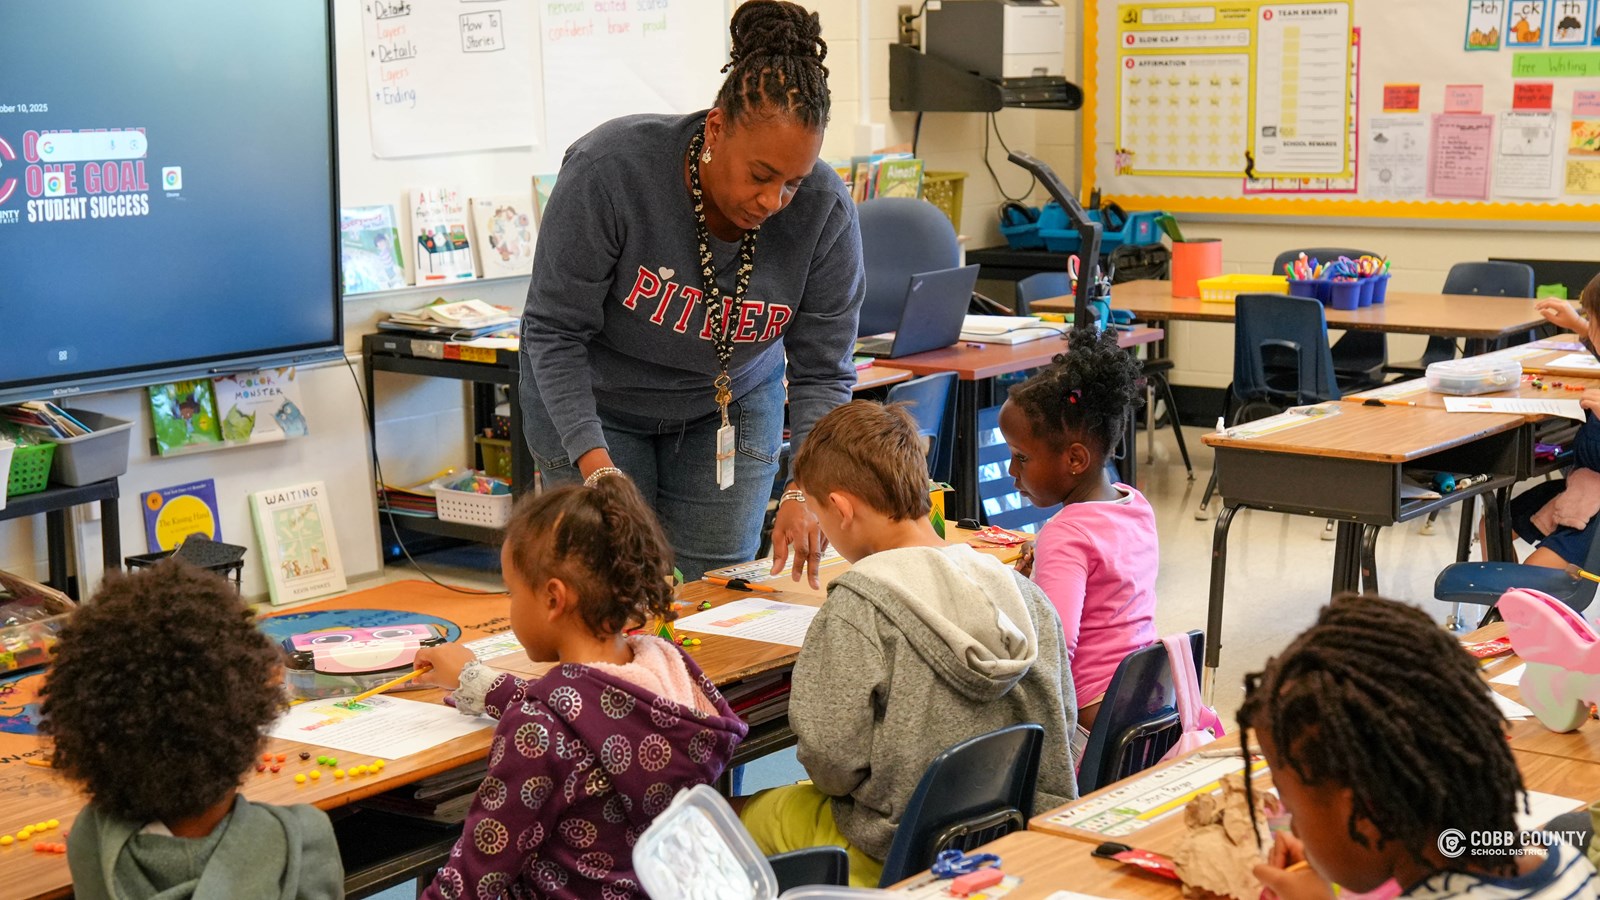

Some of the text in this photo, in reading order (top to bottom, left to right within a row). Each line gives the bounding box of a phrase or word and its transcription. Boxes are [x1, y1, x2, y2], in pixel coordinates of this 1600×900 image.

[1301, 8, 1338, 16] REWARDS
[377, 23, 406, 41] Layers
[463, 16, 482, 32] How
[467, 36, 495, 49] Stories
[379, 41, 418, 63] Details
[1139, 59, 1187, 67] AFFIRMATION
[1549, 57, 1587, 76] Writing
[381, 65, 409, 85] Layers
[383, 86, 416, 109] Ending
[29, 103, 48, 112] 2025
[25, 160, 149, 197] OE GOAL
[27, 193, 149, 223] STUDENT SUCCESS
[239, 376, 275, 388] COLOR
[235, 388, 283, 400] MONSTER
[265, 487, 318, 505] WAITING
